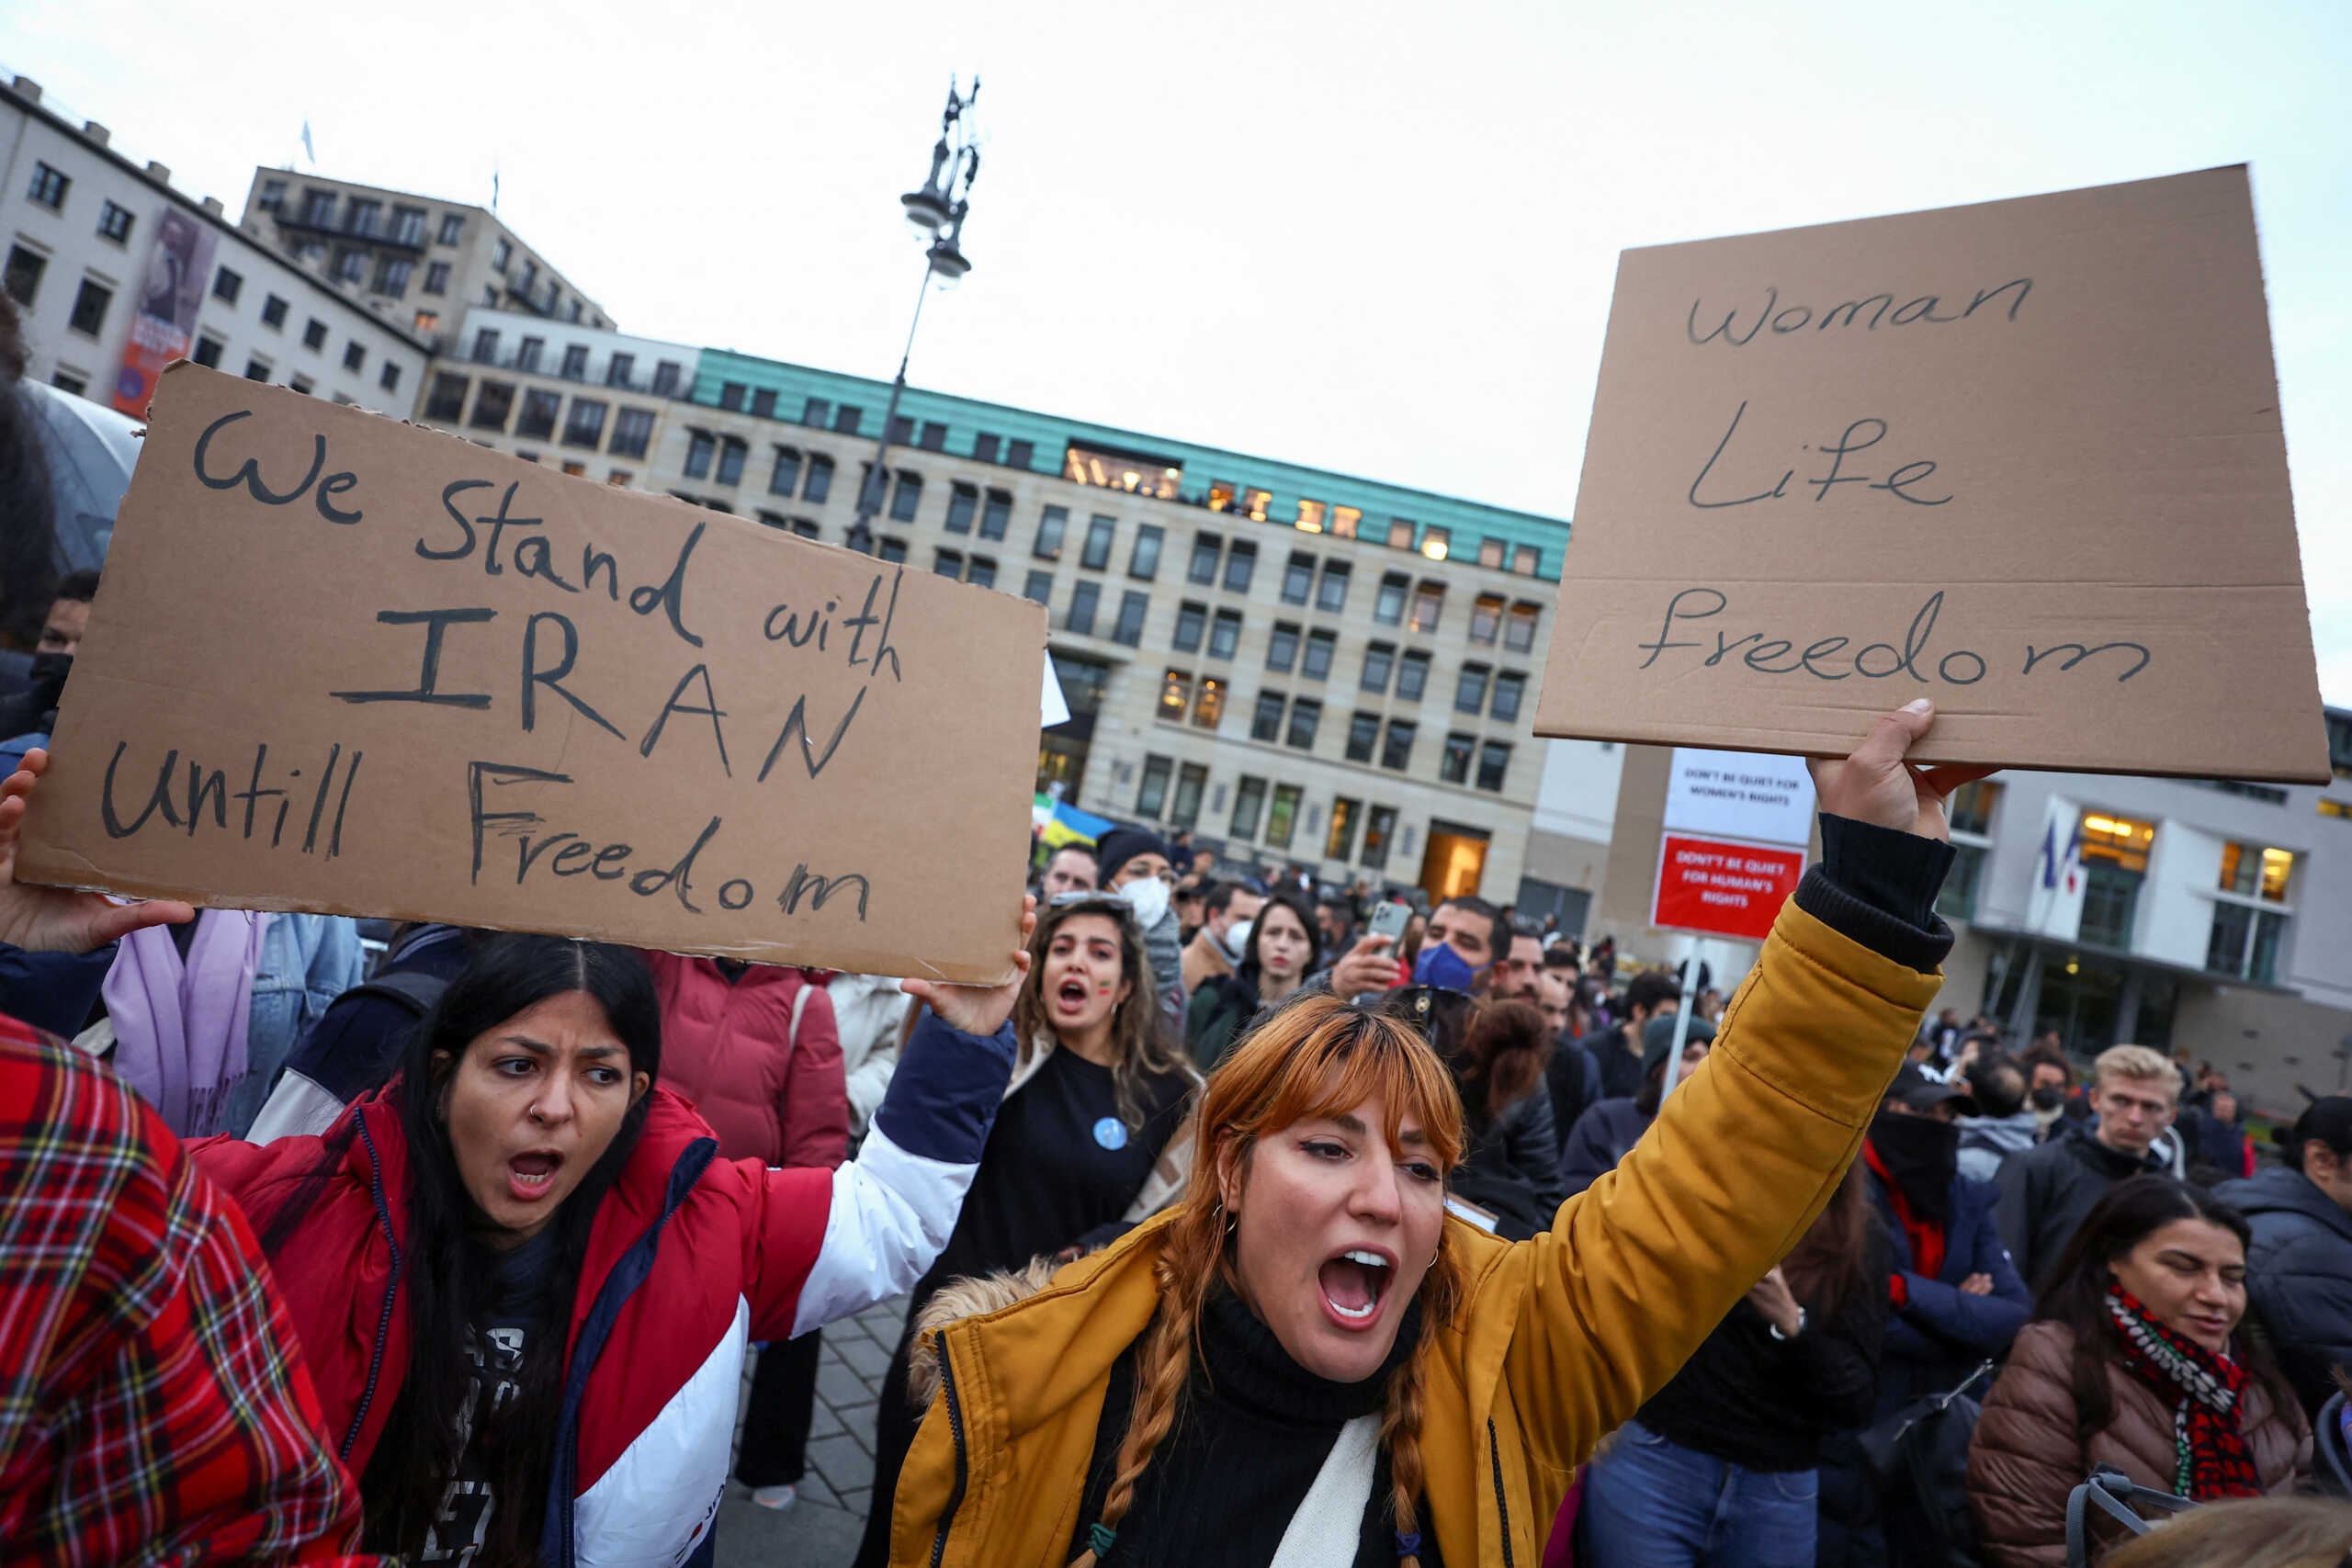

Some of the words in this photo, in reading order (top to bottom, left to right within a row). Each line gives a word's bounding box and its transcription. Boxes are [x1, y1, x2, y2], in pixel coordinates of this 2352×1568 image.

[1688, 277, 2033, 347] Woman
[1689, 400, 1955, 509] Life
[194, 411, 364, 525] We
[763, 564, 904, 683] with
[329, 606, 868, 784] IRAN
[1724, 773, 1736, 783] BE
[1740, 774, 1772, 786] QUIET
[1778, 779, 1799, 789] FOR
[1749, 792, 1789, 805] RIGHTS
[101, 740, 363, 862] Untill
[467, 761, 871, 924] Freedom
[1683, 870, 1708, 883] FOR
[1711, 875, 1773, 893] HUMAN'S
[1726, 858, 1741, 869] BE
[1745, 859, 1785, 874] QUIET
[1702, 892, 1748, 907] RIGHTS
